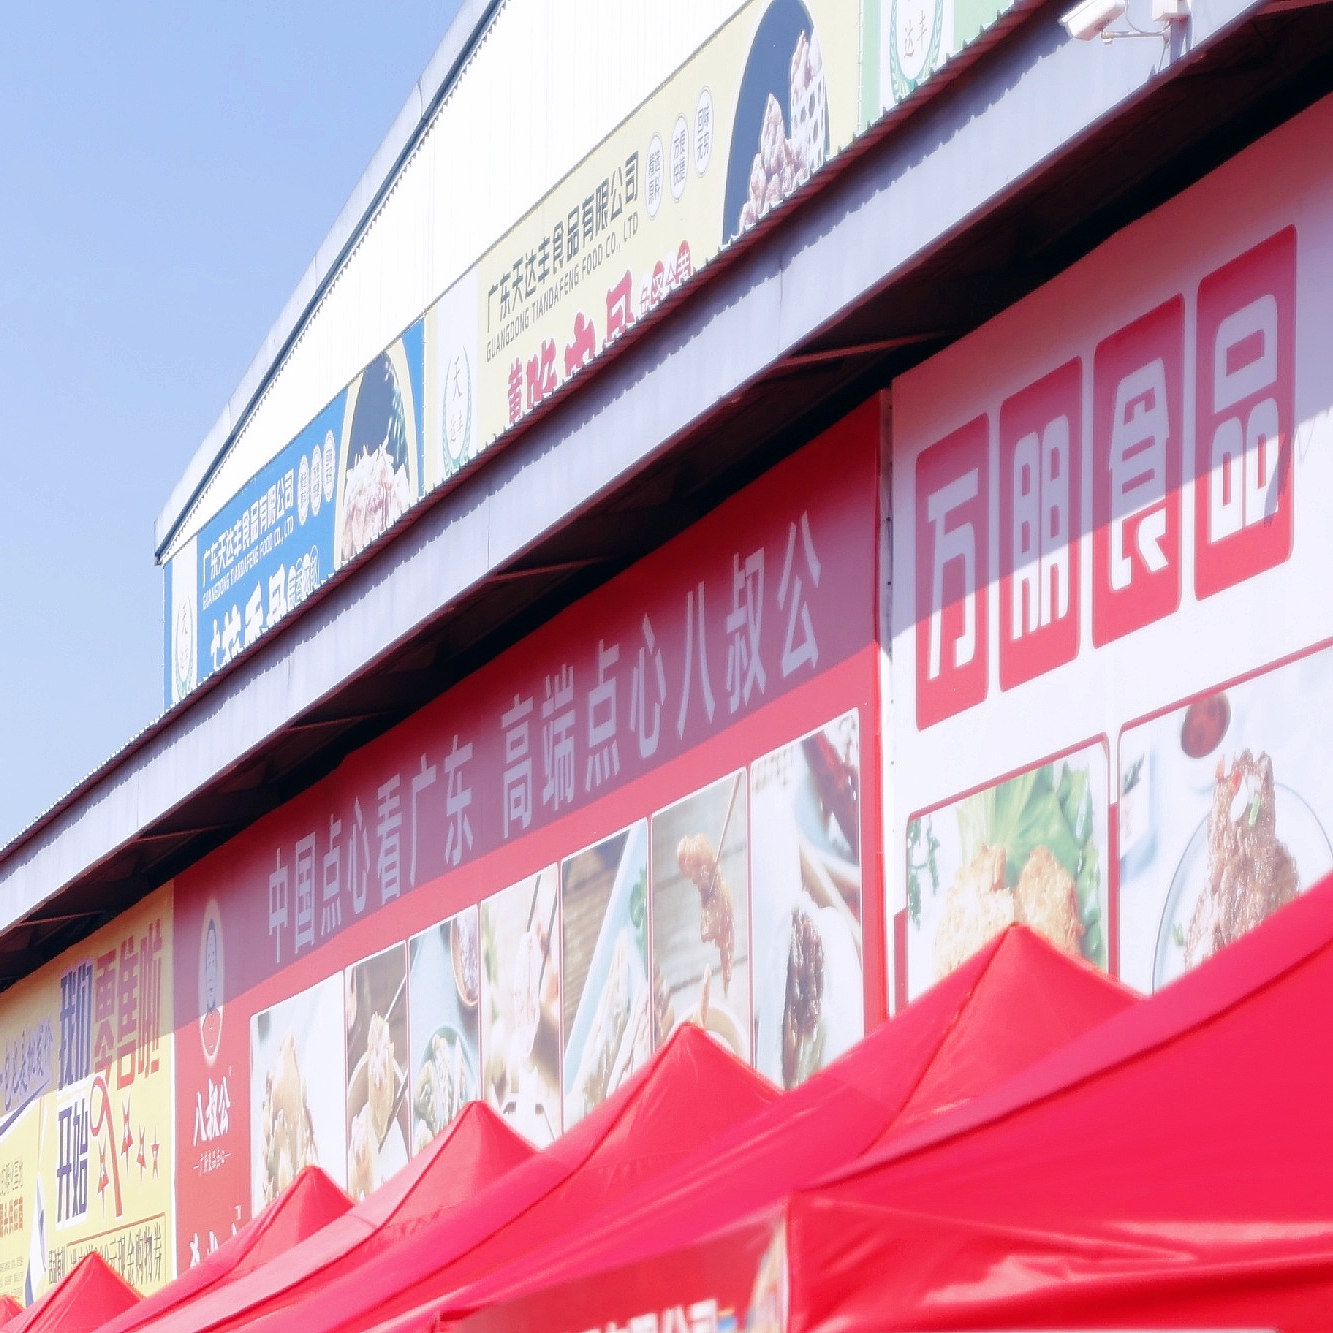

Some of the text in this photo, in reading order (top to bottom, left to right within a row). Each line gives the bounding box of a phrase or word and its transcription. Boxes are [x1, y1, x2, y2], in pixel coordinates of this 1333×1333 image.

[486, 309, 530, 363] GUANGDONG
[531, 270, 580, 323] TIANDAFENG
[581, 252, 604, 282] FOOD
[623, 211, 639, 244] LTD
[487, 150, 639, 334] 广东天达丰食品有限公司
[202, 467, 295, 588] 广东天达丰食品有限公司
[202, 575, 231, 612] GUANGDONG
[268, 733, 475, 966] 中国点心看广东
[501, 510, 822, 841] 高端点心八叔公
[56, 1097, 89, 1224] 开始
